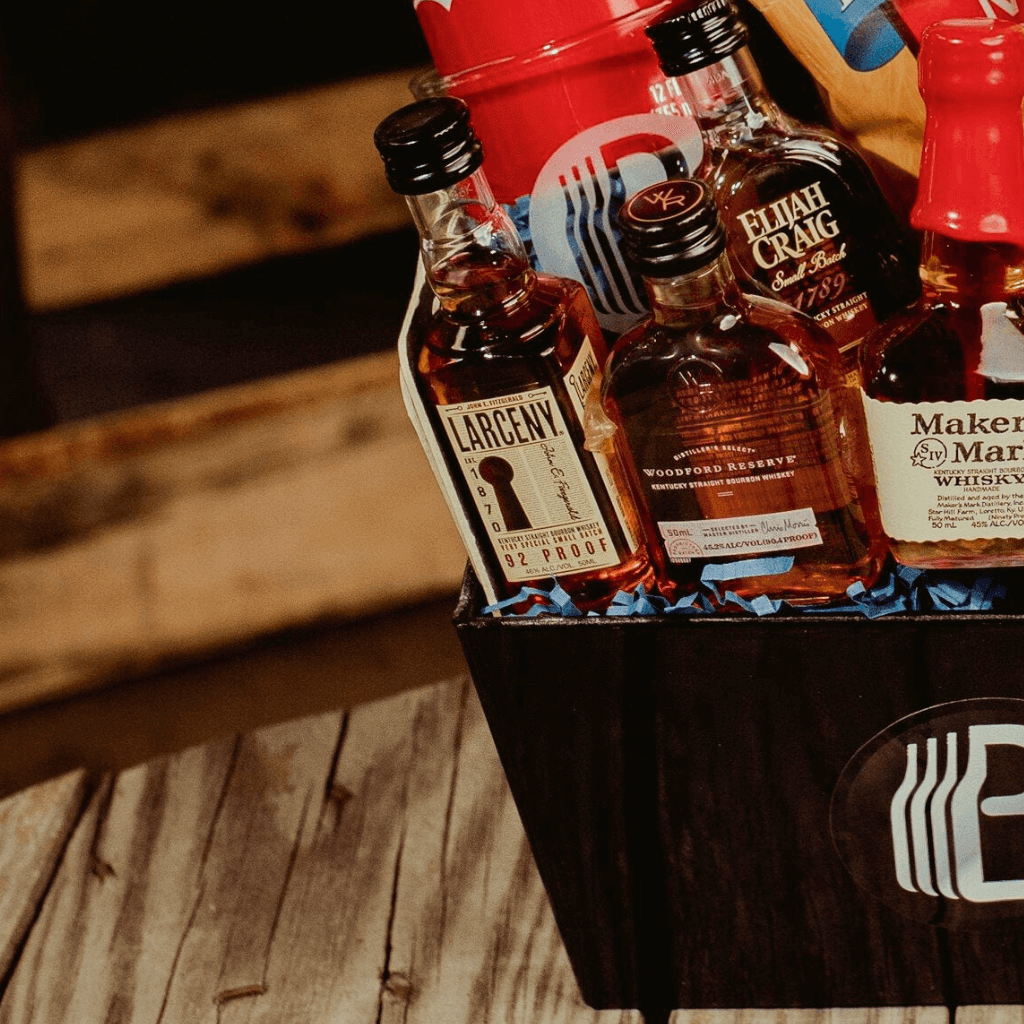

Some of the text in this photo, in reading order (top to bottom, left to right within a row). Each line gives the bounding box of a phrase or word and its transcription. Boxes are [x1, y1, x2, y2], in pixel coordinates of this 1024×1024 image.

[736, 180, 830, 244] ELIJAH
[752, 209, 840, 270] CRAIG
[771, 242, 847, 292] Small Batch
[794, 273, 846, 310] 1789
[831, 292, 868, 316] STRAIGHT
[489, 394, 523, 406] FITZGERALD
[447, 400, 558, 453] LARCENY
[673, 445, 719, 461] DISTILLER'S
[920, 443, 929, 453] S
[929, 451, 943, 461] IV
[642, 455, 793, 480] WOODFORD RESERVE
[650, 469, 794, 492] KENTUCKY STRAIGHT BOURBON WHISKEY
[497, 521, 599, 546] KENTUCKY STRAIGHT BOURBON WHISKEY
[667, 527, 692, 538] 50mL
[931, 521, 943, 529] 50
[500, 528, 602, 552] VERY SPECIAL SMALL BATCH
[503, 536, 608, 569] 92 PROOF
